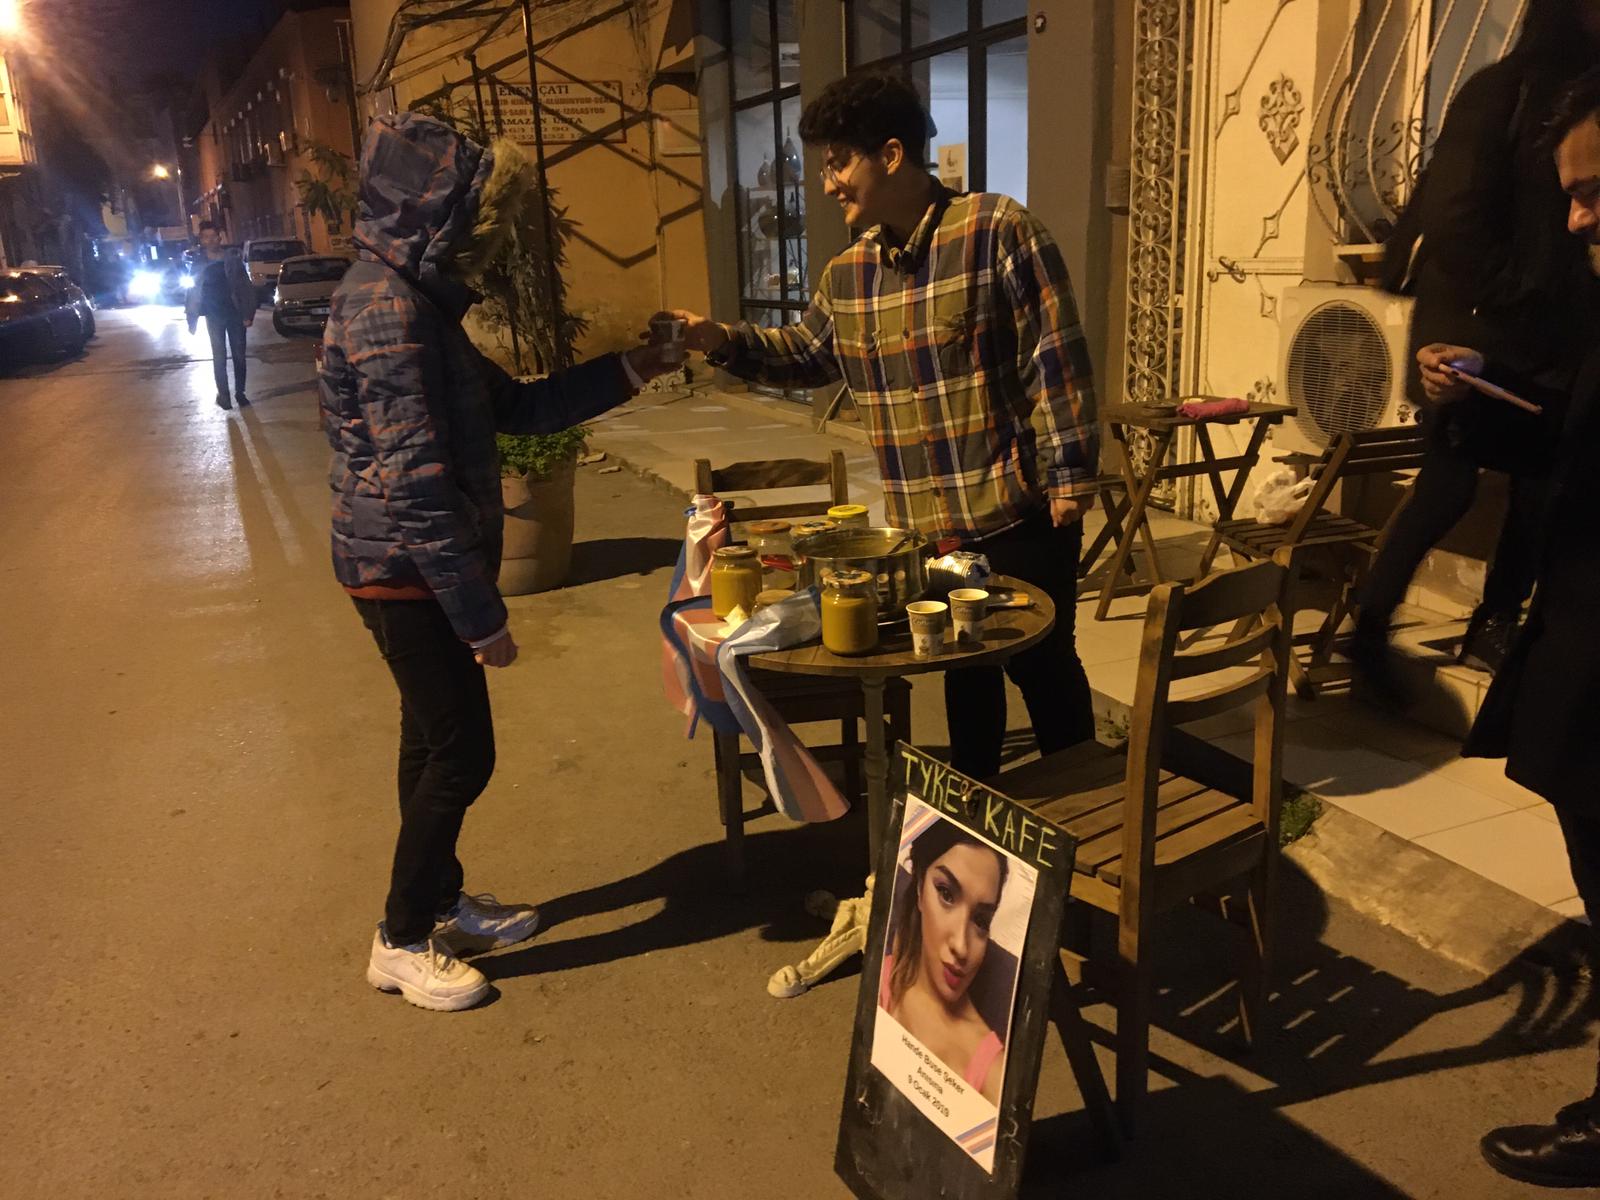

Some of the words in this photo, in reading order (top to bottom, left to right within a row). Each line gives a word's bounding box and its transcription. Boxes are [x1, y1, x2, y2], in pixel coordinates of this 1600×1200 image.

[901, 751, 961, 813] TYKE
[985, 794, 1057, 867] KAFE
[902, 1034, 923, 1058] Hande
[924, 1054, 942, 1076] Buse
[913, 1080, 931, 1101] Ocak
